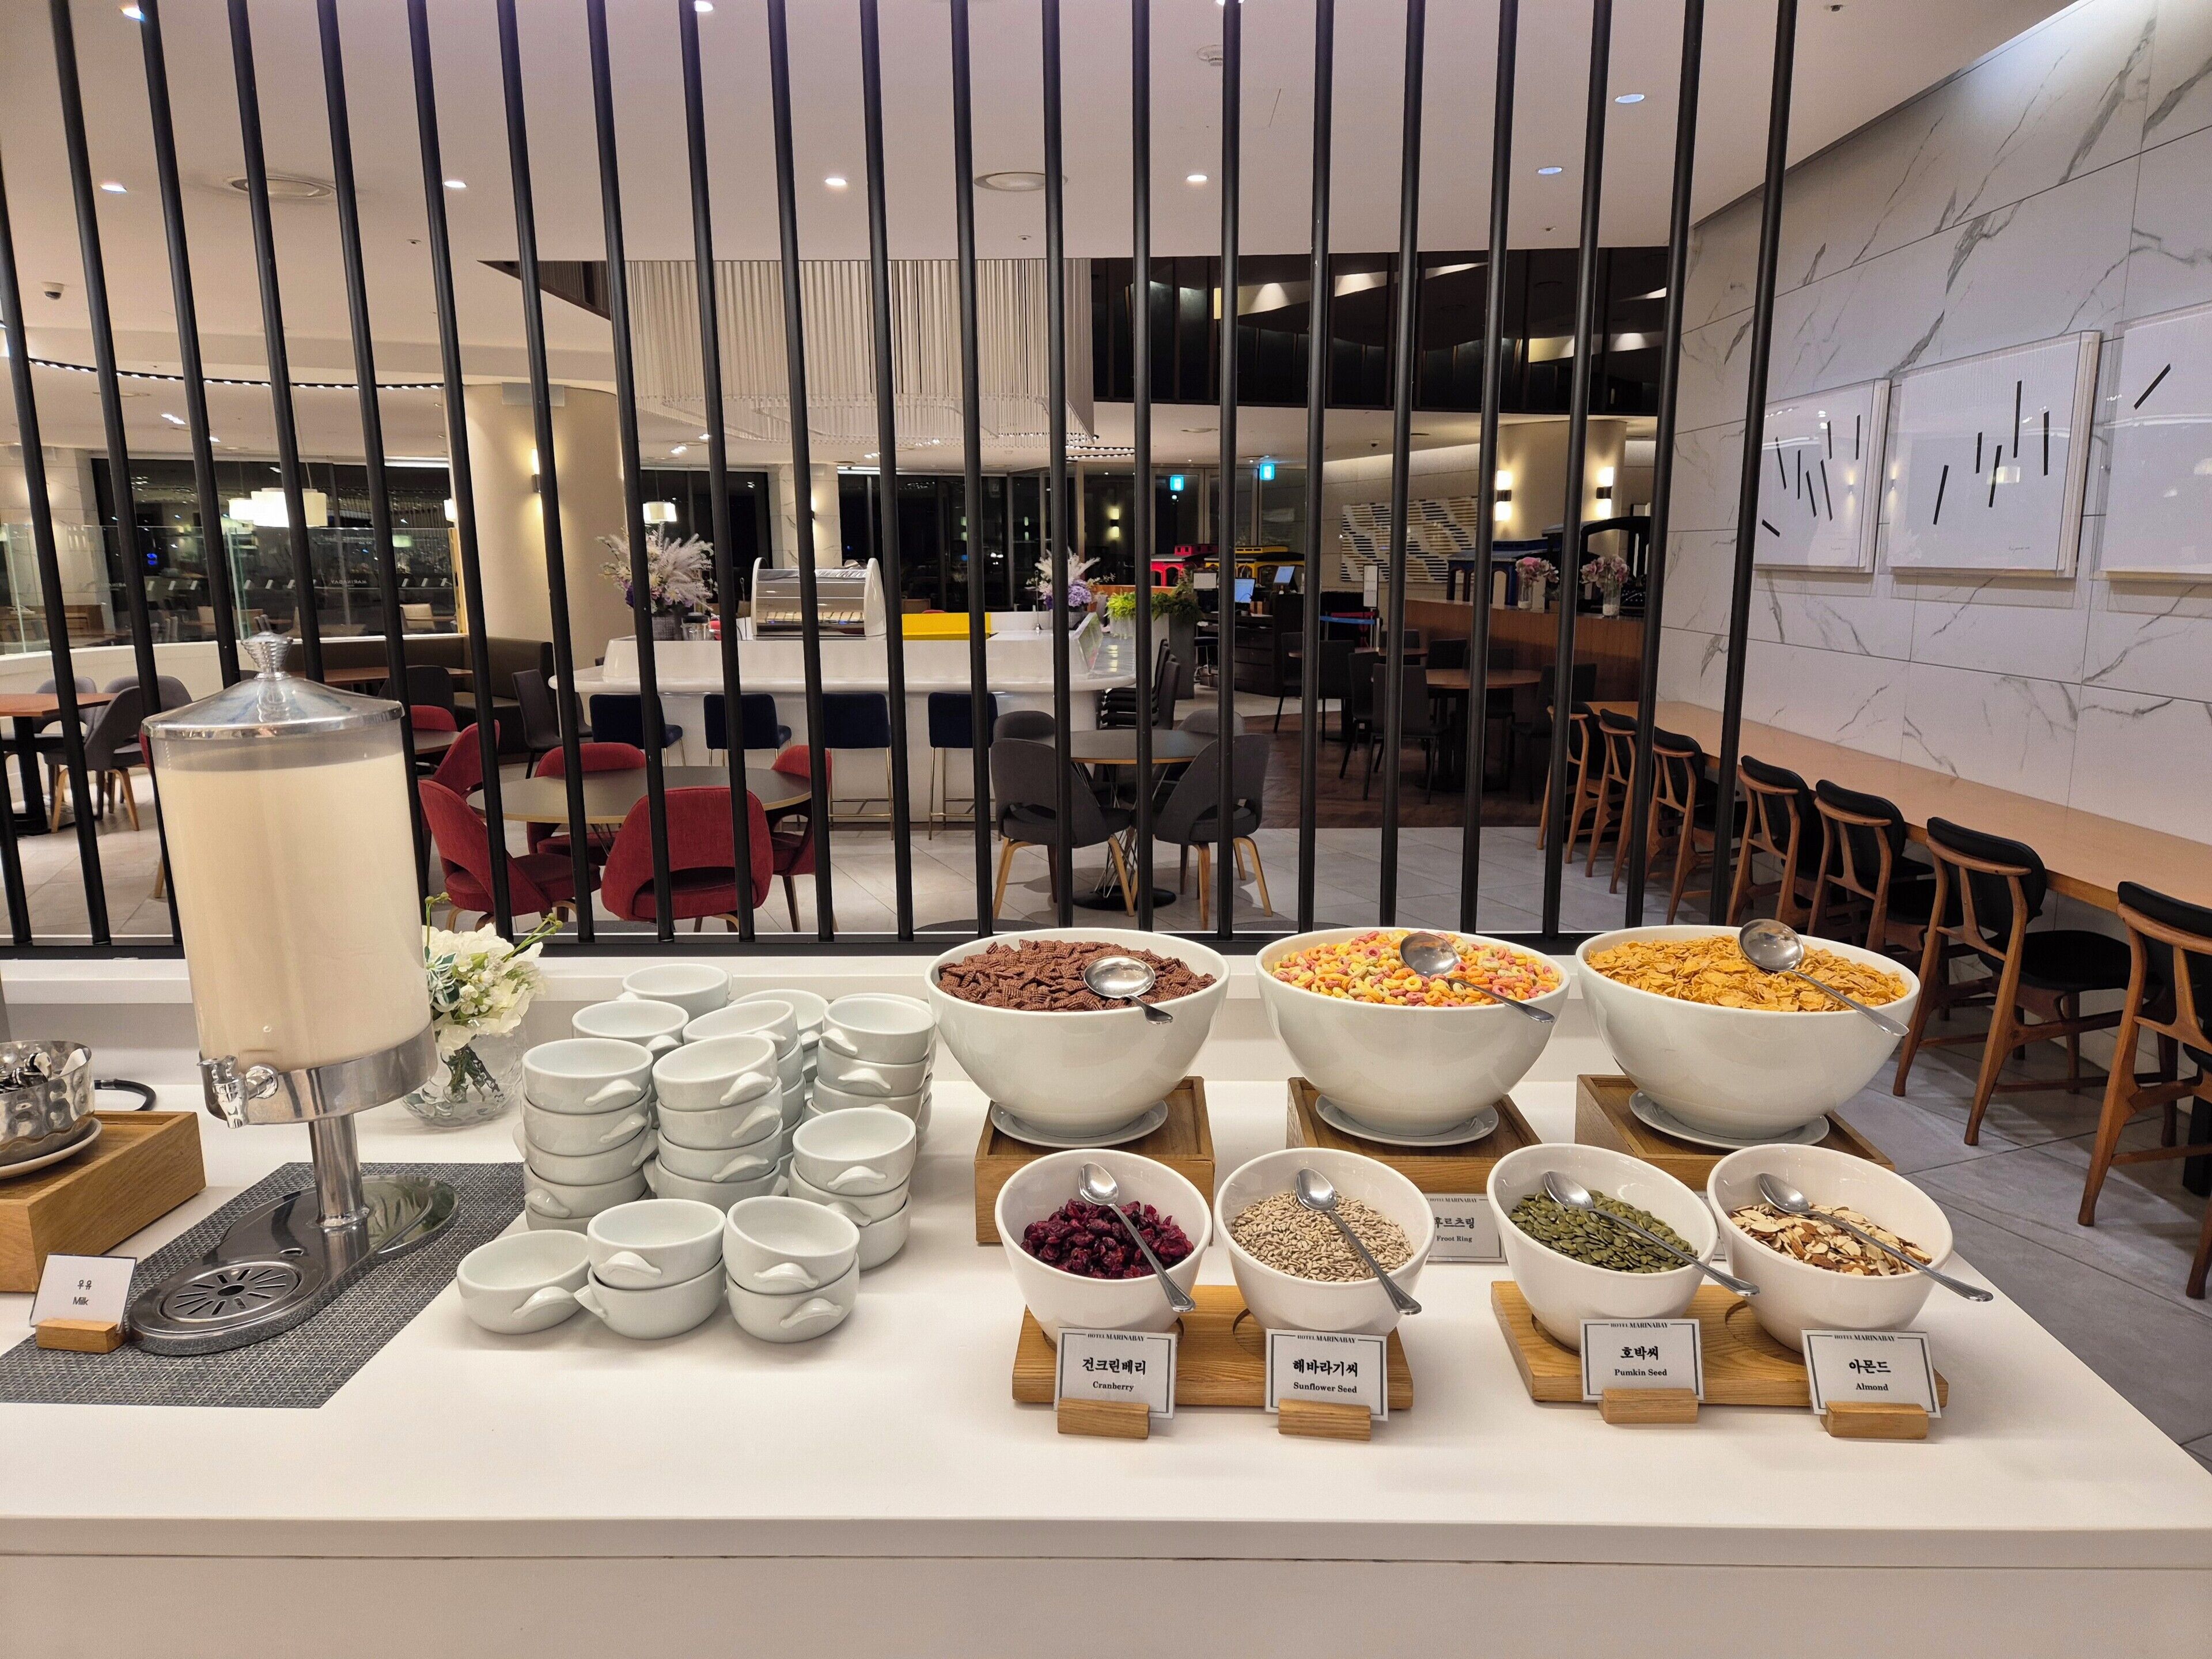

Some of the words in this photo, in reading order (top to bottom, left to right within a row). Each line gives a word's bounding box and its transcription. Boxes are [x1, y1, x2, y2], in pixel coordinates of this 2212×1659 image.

[1434, 1217, 1475, 1229] 후르츠링
[1456, 1235, 1472, 1243] Ring
[77, 1279, 92, 1290] 우유
[73, 1296, 89, 1306] Milk
[1105, 1334, 1145, 1342] MARINABAY
[1316, 1335, 1356, 1343] MARINABAY
[1620, 1346, 1659, 1361] 호박씨
[1082, 1357, 1146, 1376] 건크린베리
[1292, 1358, 1358, 1378] 해바라기씨
[1849, 1358, 1892, 1374] 아몬드
[1092, 1381, 1135, 1392] Cranberry
[1293, 1382, 1336, 1392] Sunflower
[1337, 1385, 1358, 1393] Seed
[1855, 1382, 1889, 1391] Almond
